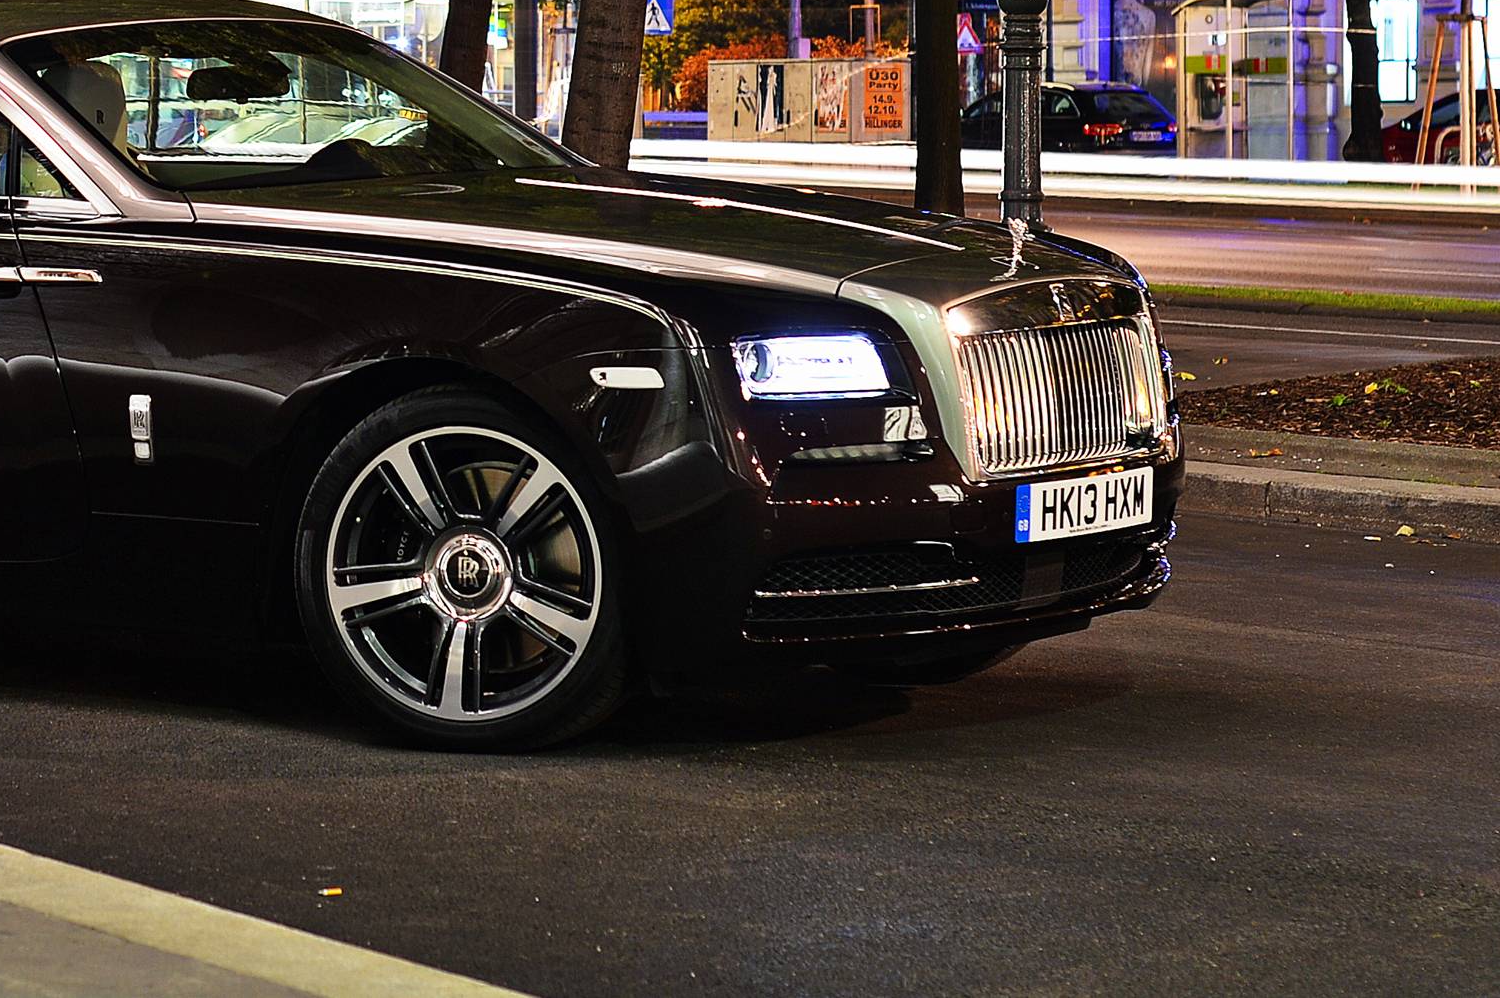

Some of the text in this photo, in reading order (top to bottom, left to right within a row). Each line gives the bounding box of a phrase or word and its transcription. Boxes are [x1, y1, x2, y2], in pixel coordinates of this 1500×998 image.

[869, 68, 899, 81] Ü30
[869, 82, 898, 90] Party
[868, 105, 897, 115] 12.10.
[1041, 474, 1145, 532] HK13 HXM
